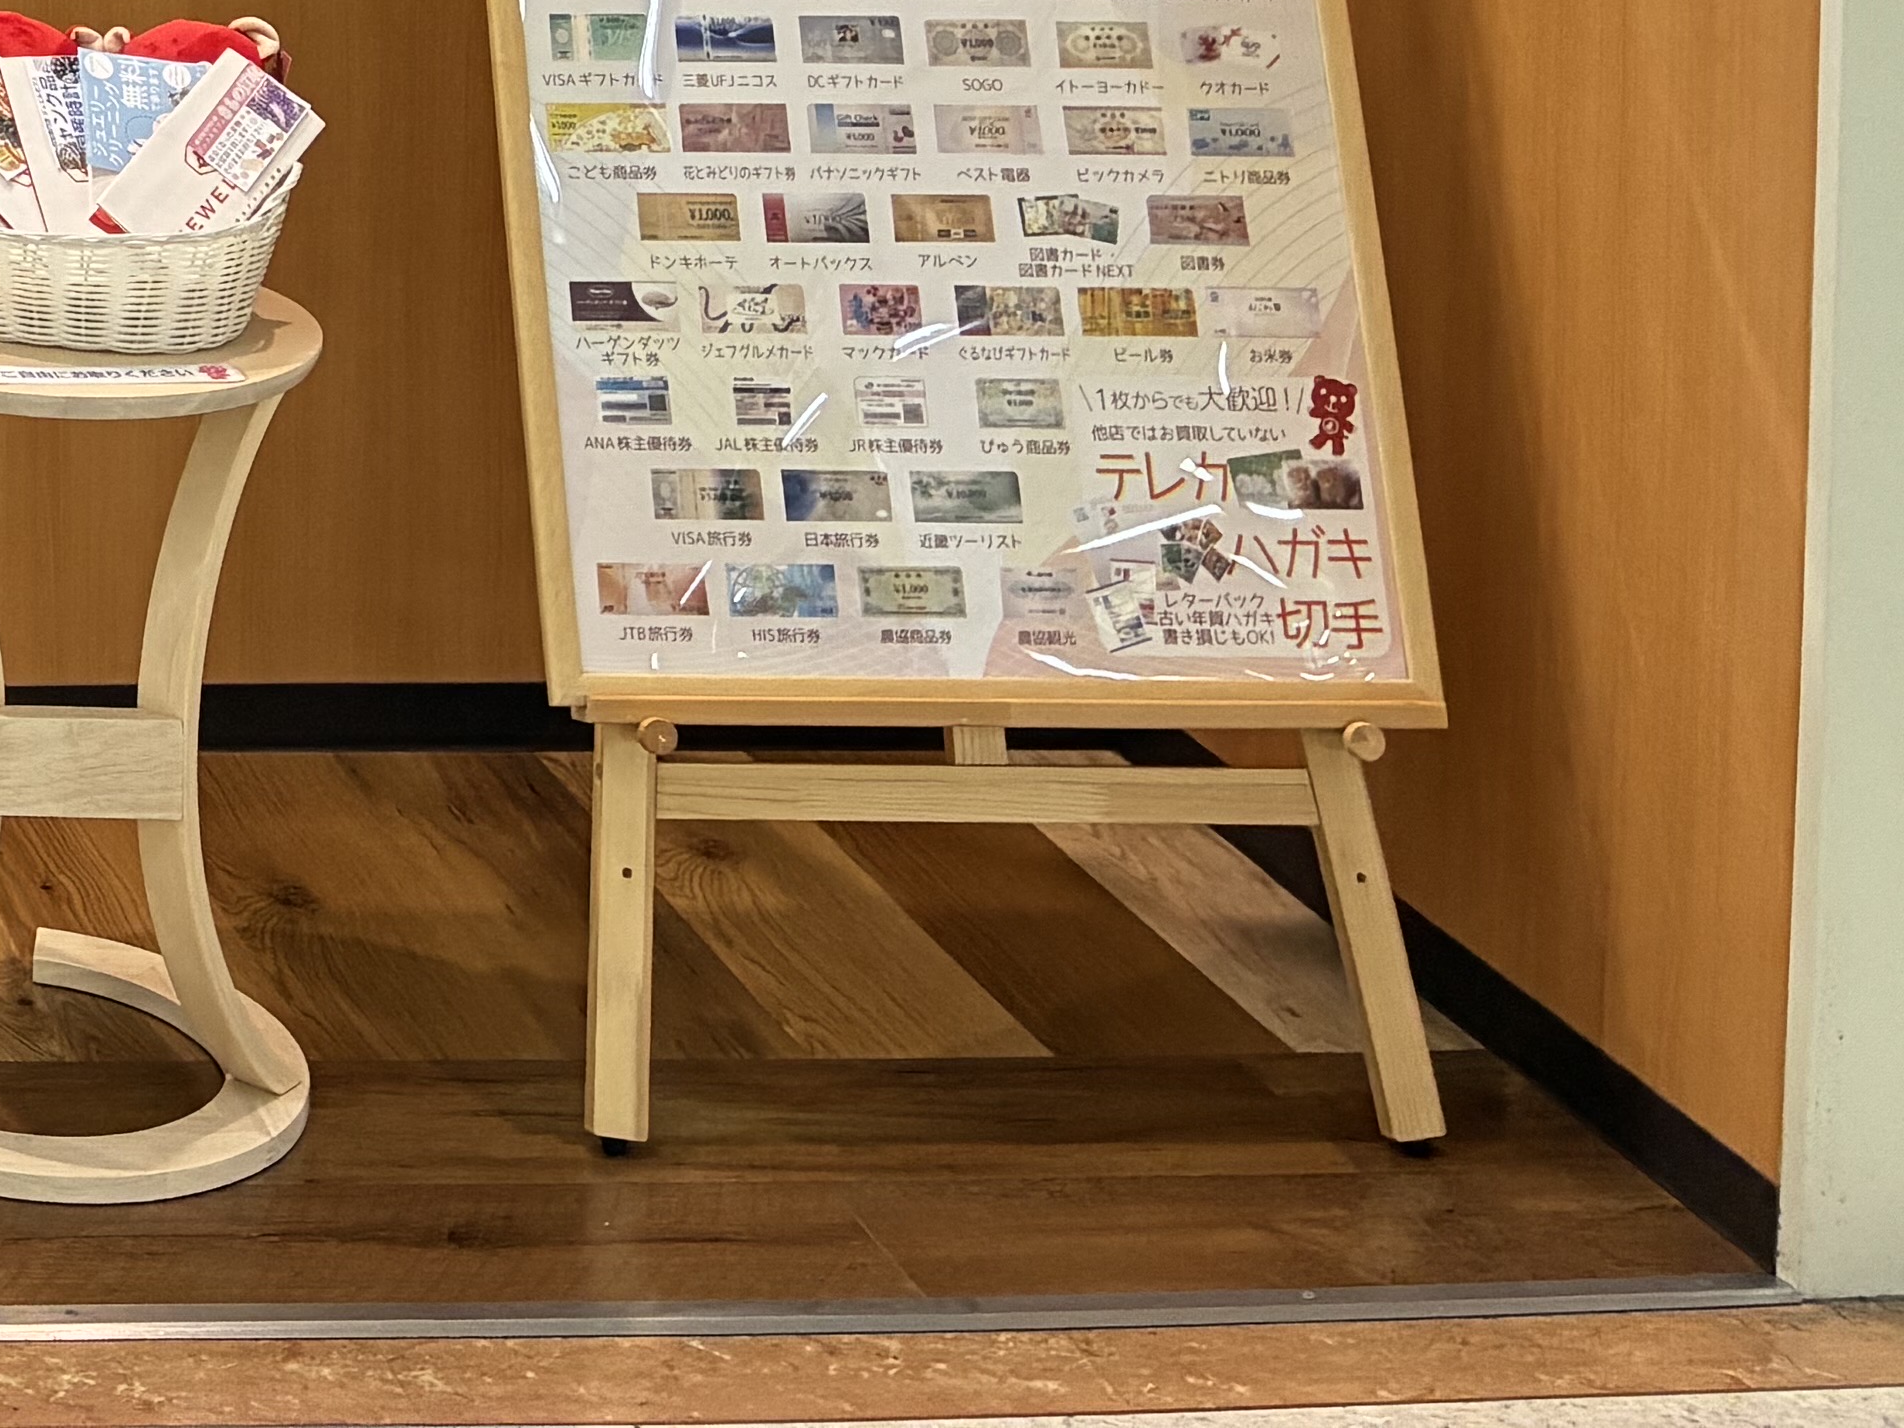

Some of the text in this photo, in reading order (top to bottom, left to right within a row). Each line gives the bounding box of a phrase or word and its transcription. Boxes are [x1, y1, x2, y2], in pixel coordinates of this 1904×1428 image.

[117, 58, 149, 111] 無料
[541, 72, 664, 88] VISAギフトカド
[961, 77, 1004, 93] SOGO
[91, 84, 108, 157] ジュエリー
[104, 80, 125, 166] クリーニング
[179, 178, 237, 232] EWEL
[1095, 450, 1229, 502] テレカ
[1225, 524, 1373, 579] ハガキ
[1275, 597, 1383, 650] 切手
